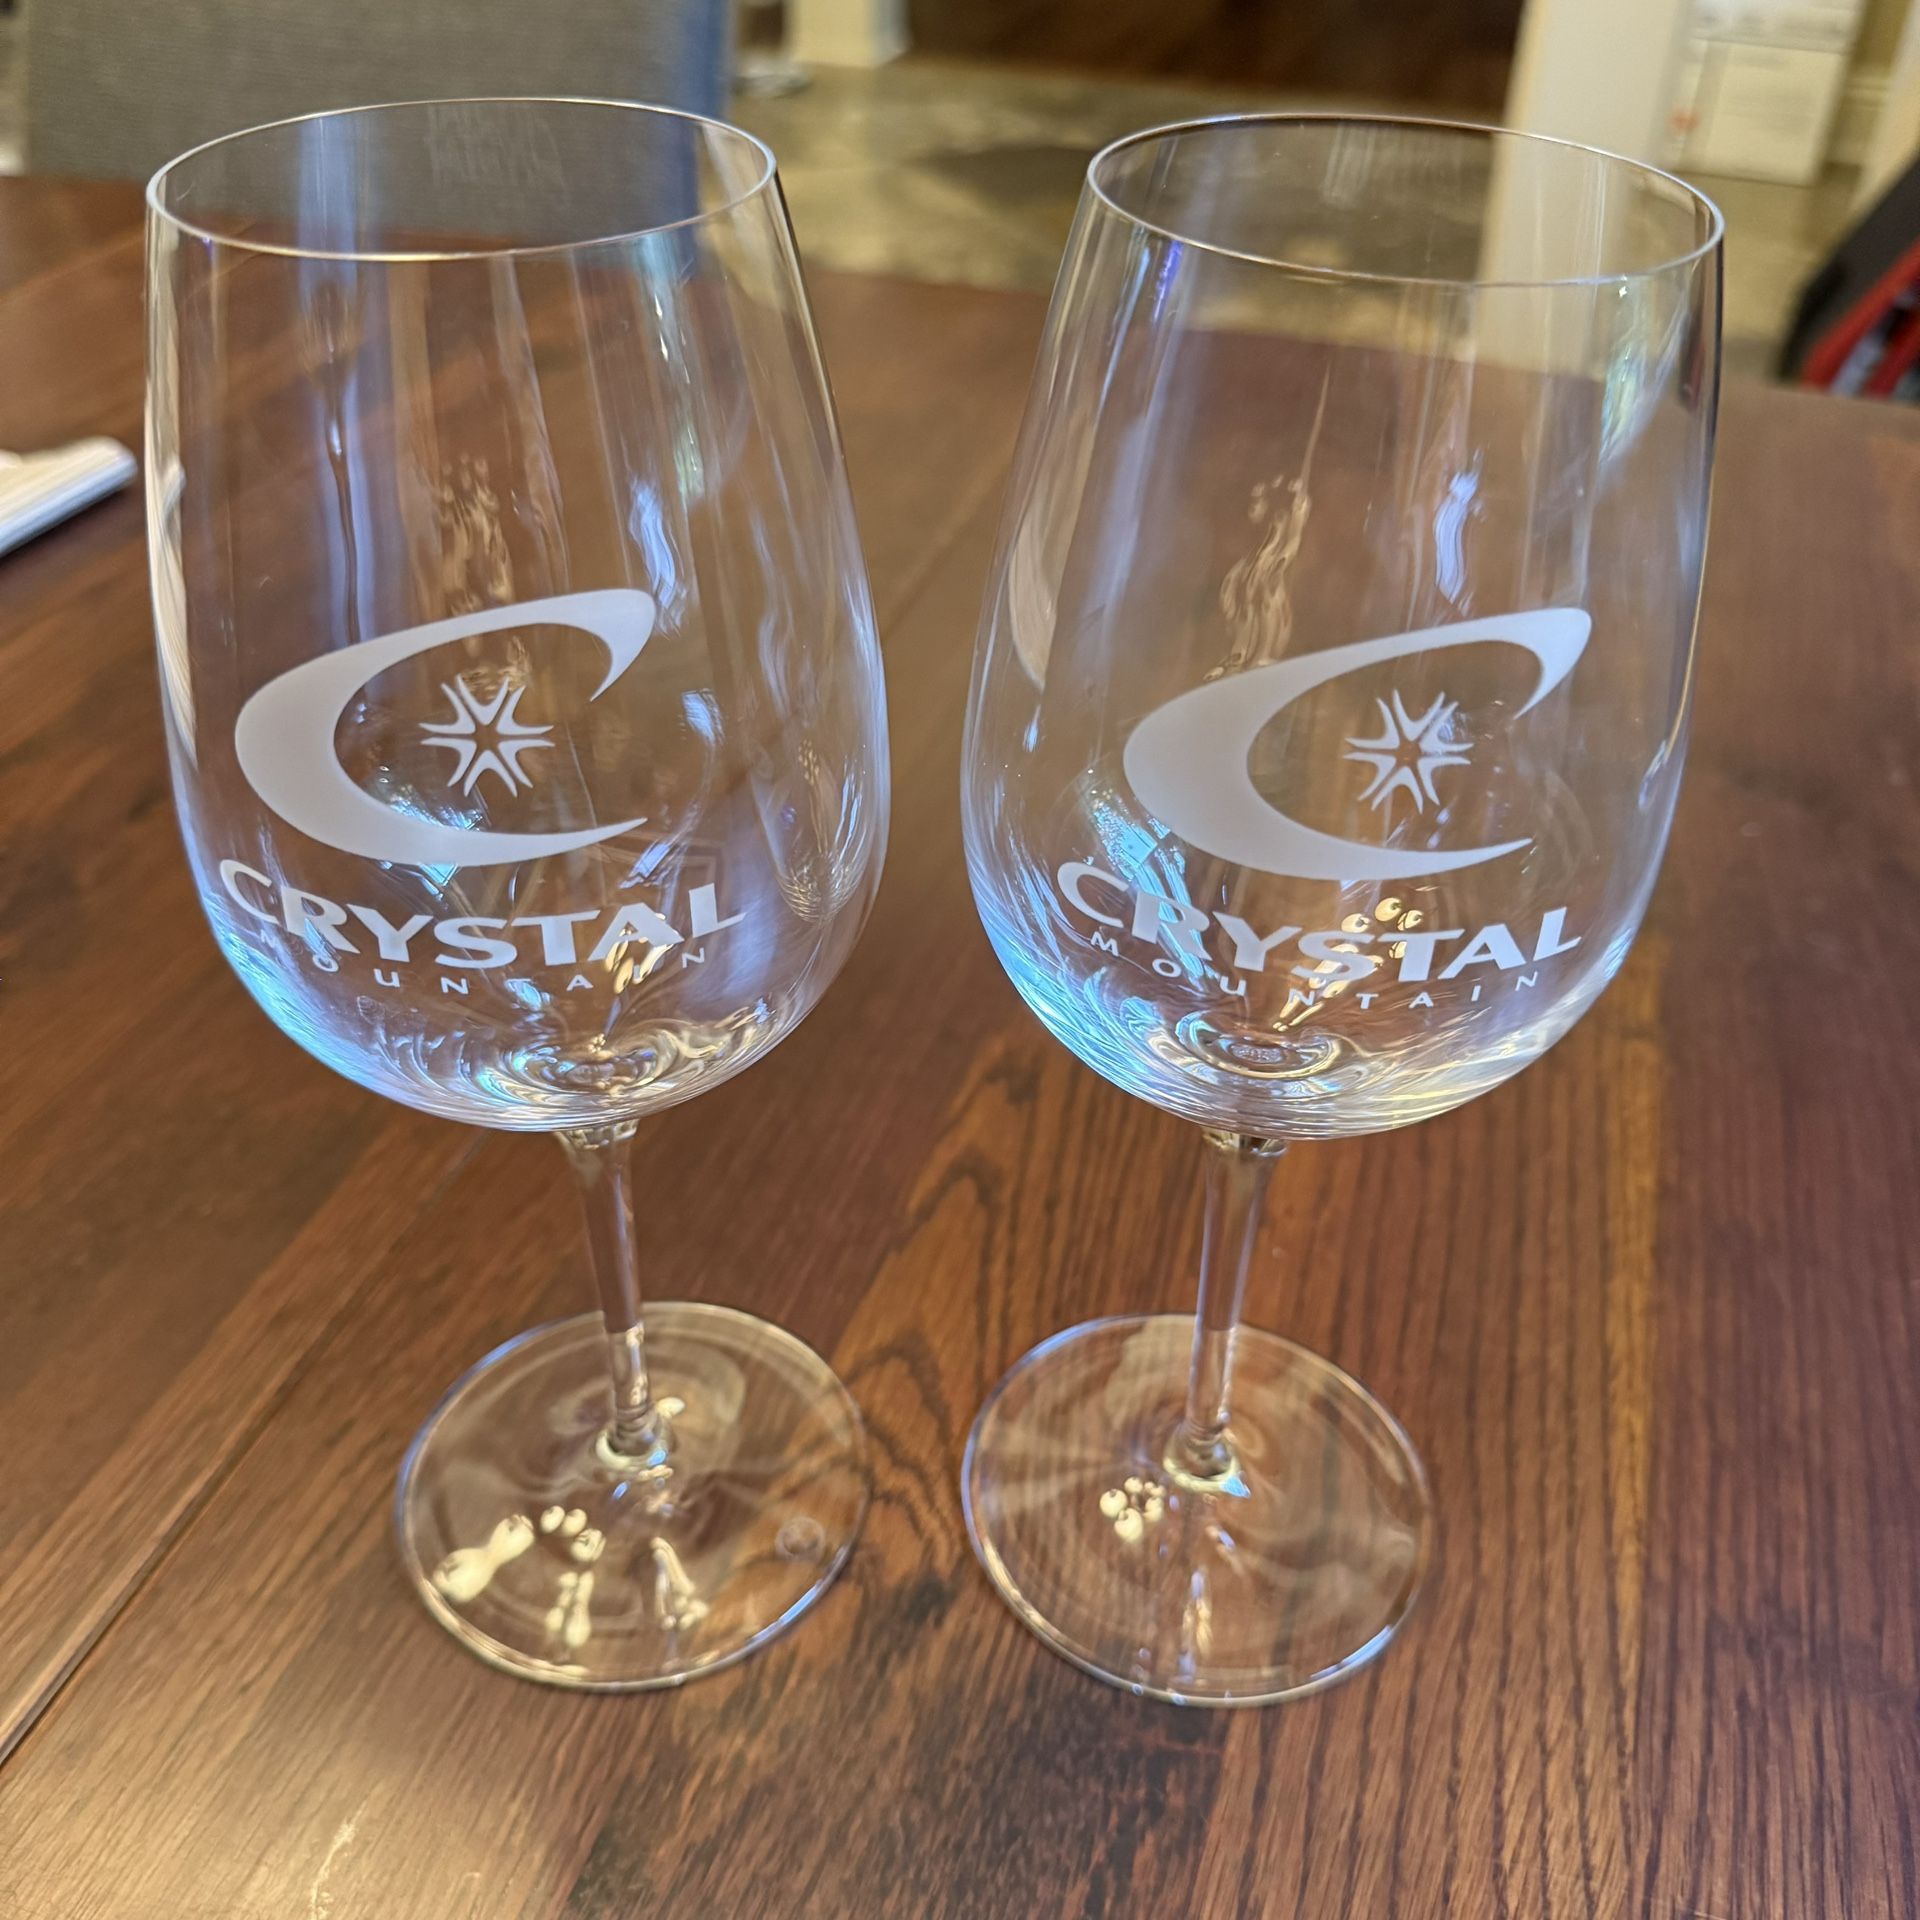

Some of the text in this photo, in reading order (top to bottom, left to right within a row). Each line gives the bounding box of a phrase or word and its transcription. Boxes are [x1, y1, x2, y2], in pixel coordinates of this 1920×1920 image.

[218, 859, 747, 968] CRYSTAL
[1057, 861, 1582, 982] CRYSTAL
[1091, 930, 1540, 1010] MOUNTAIN
